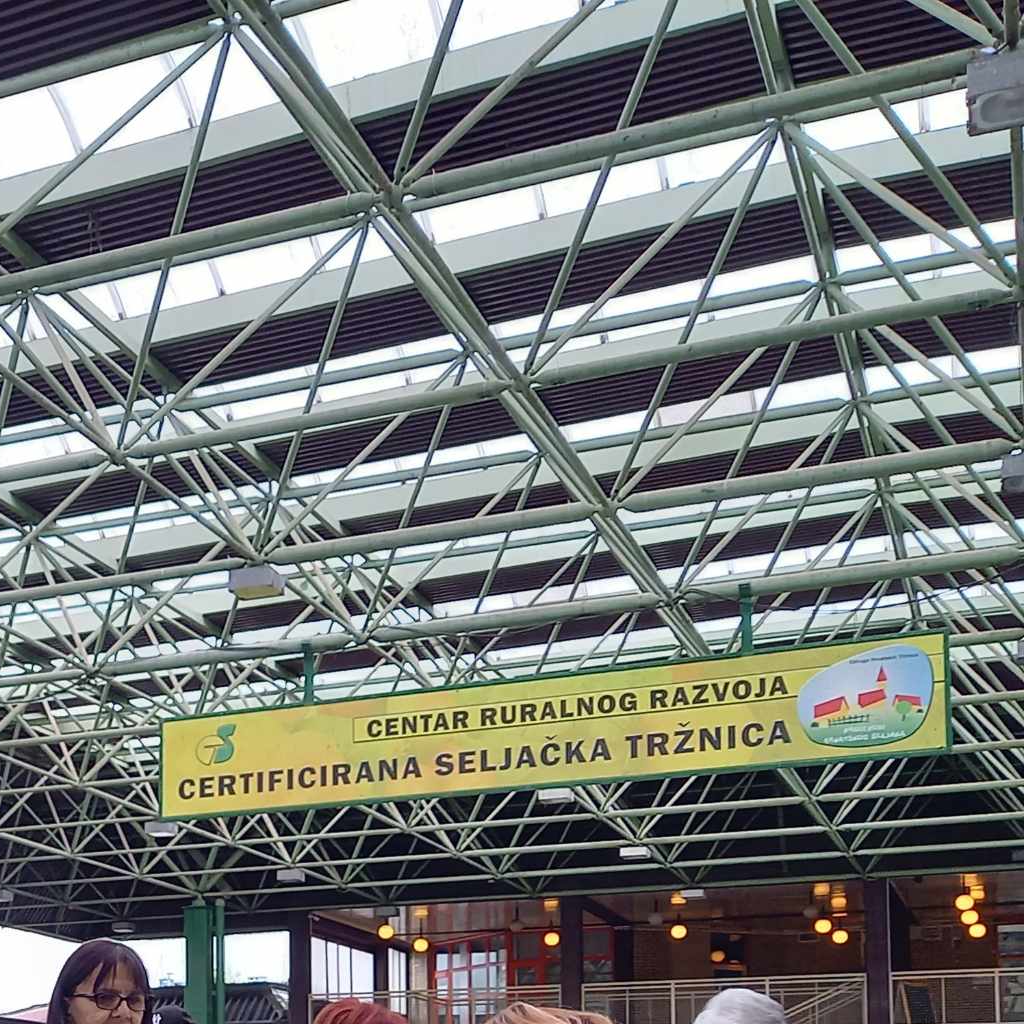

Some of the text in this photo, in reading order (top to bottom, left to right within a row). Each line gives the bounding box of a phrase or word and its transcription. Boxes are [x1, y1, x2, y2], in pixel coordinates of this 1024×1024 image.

[367, 675, 789, 738] CENTAR RURALNOG RAZVOJA
[178, 719, 792, 800] CERTIFICIRANA SELJAČKA TRŽNICA
